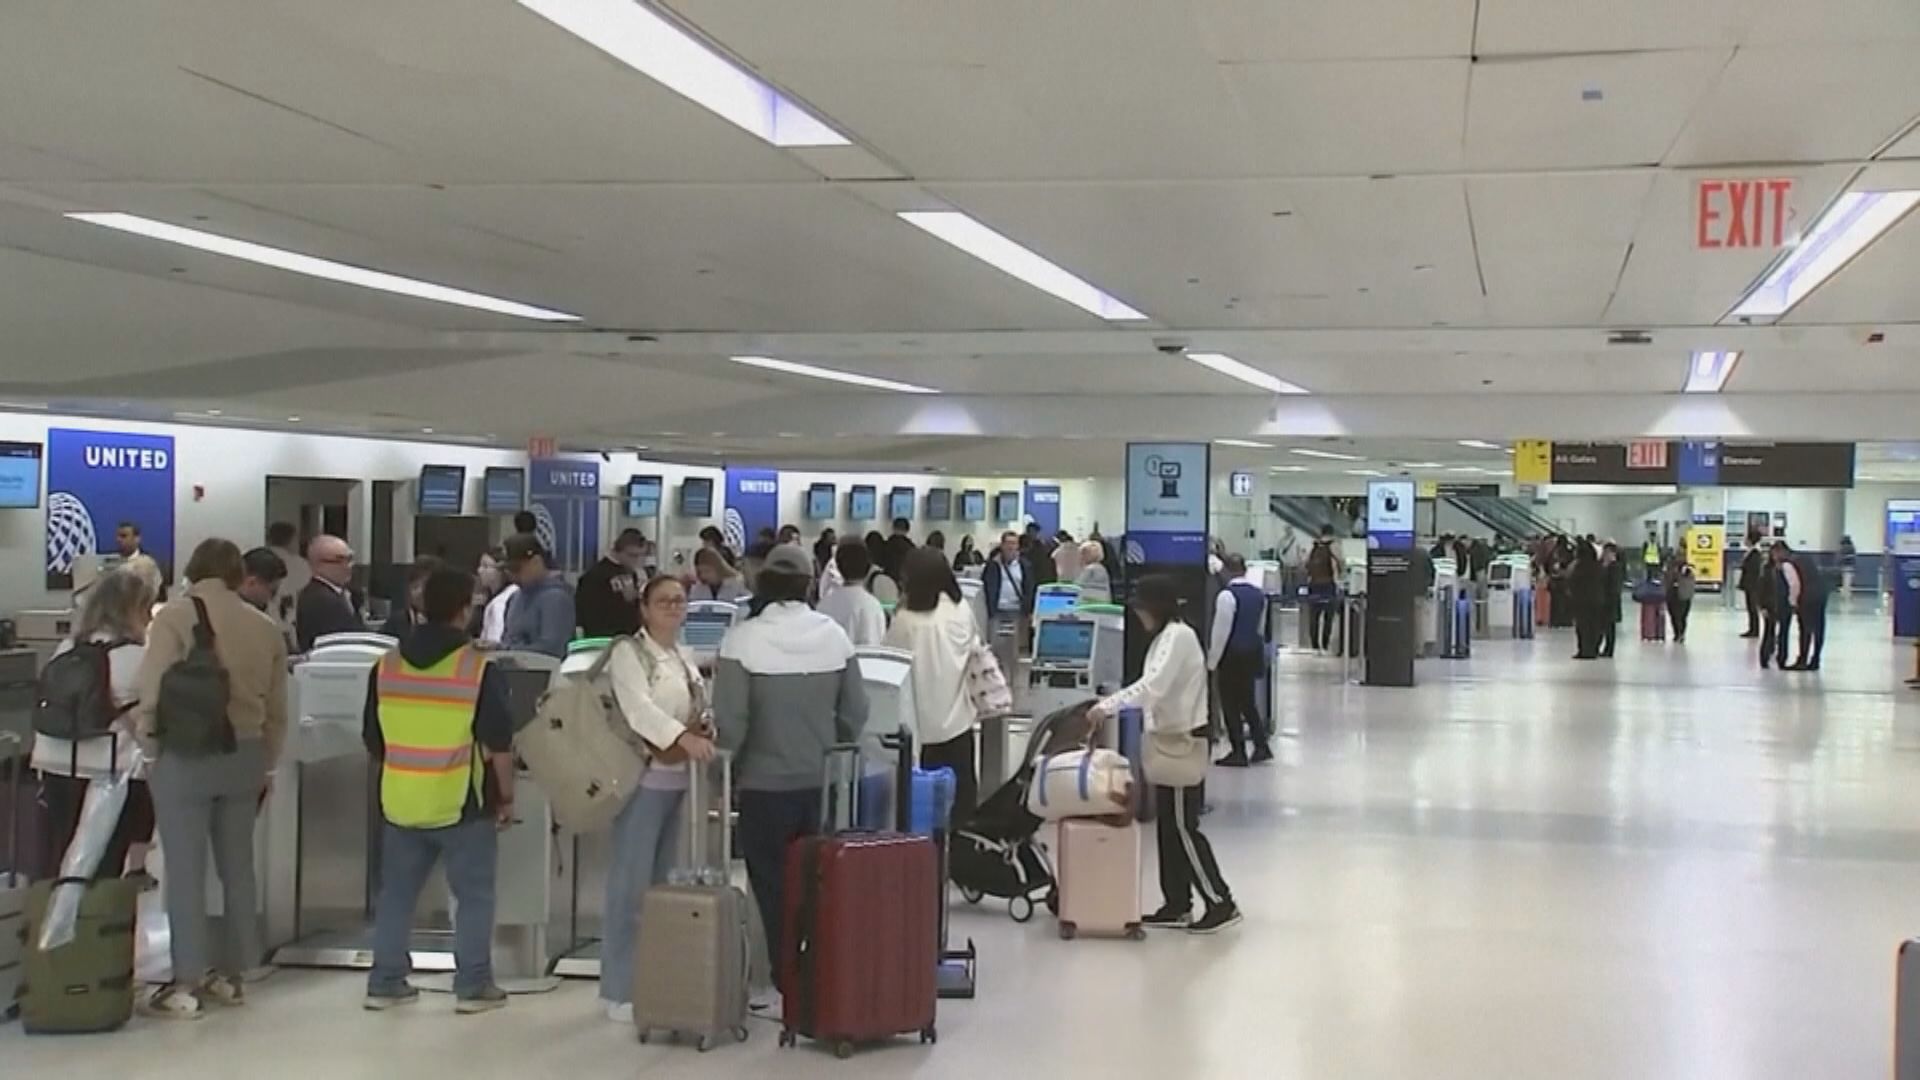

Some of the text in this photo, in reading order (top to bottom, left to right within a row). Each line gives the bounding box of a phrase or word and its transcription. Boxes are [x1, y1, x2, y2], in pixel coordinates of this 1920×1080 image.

[1698, 181, 1791, 248] EXIT
[86, 446, 168, 469] UNITED
[1570, 454, 1597, 463] Gates
[1631, 442, 1662, 465] EXIT
[1722, 456, 1762, 465] Elevator
[549, 471, 597, 487] UNITED
